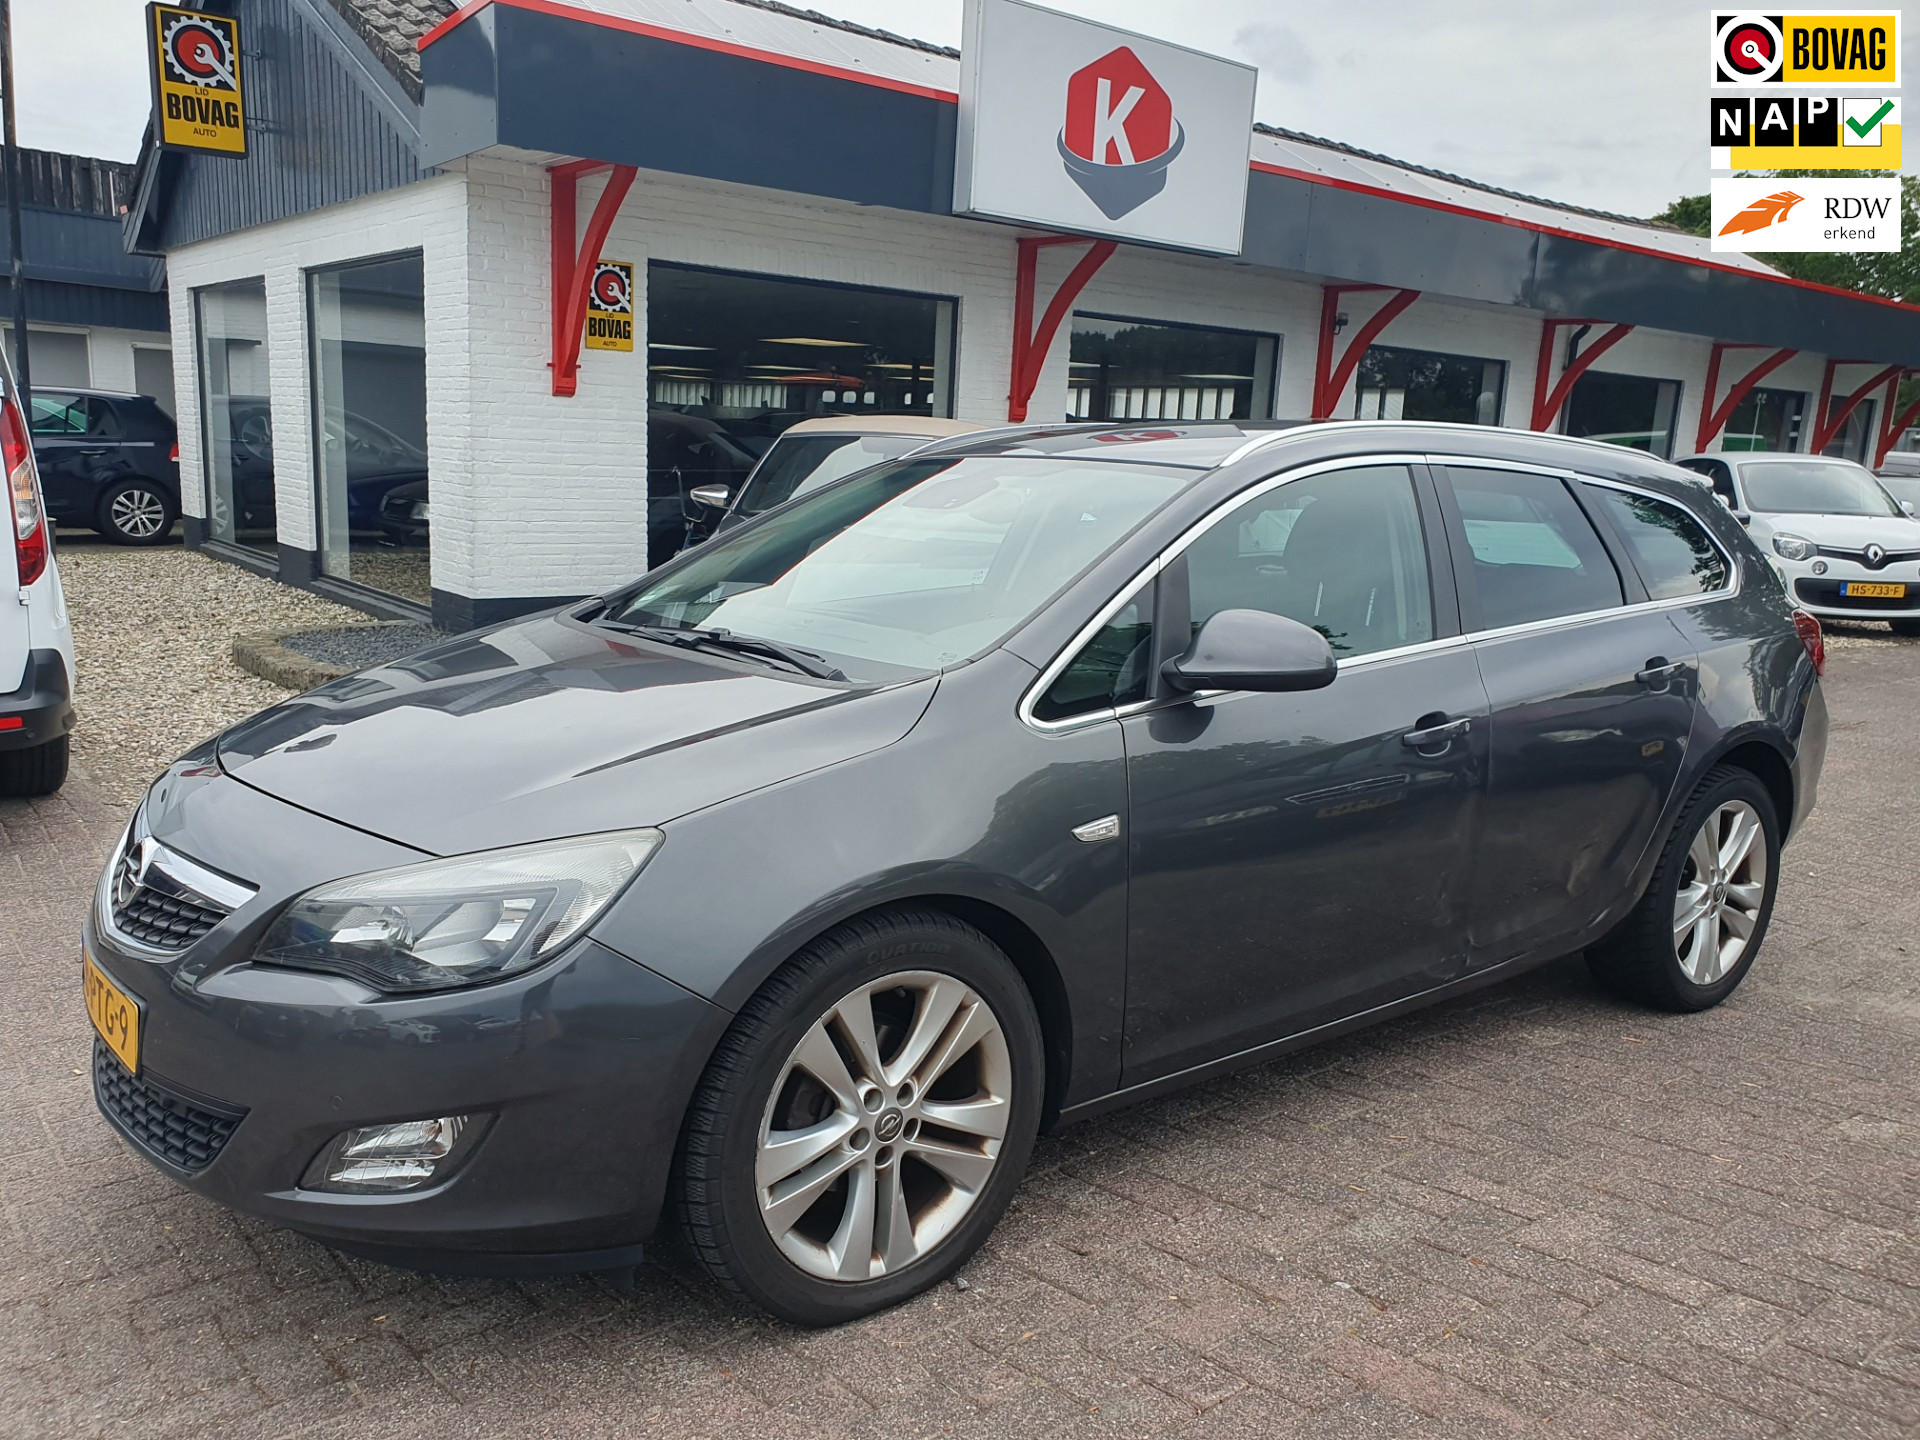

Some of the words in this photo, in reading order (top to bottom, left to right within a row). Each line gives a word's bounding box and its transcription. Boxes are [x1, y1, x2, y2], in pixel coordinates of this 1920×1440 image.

[195, 87, 209, 96] LID
[167, 92, 240, 129] BOVAG
[1092, 77, 1146, 165] K
[193, 127, 217, 138] AUTO
[588, 317, 631, 340] BOVAG
[1851, 585, 1900, 596] HS-733-F
